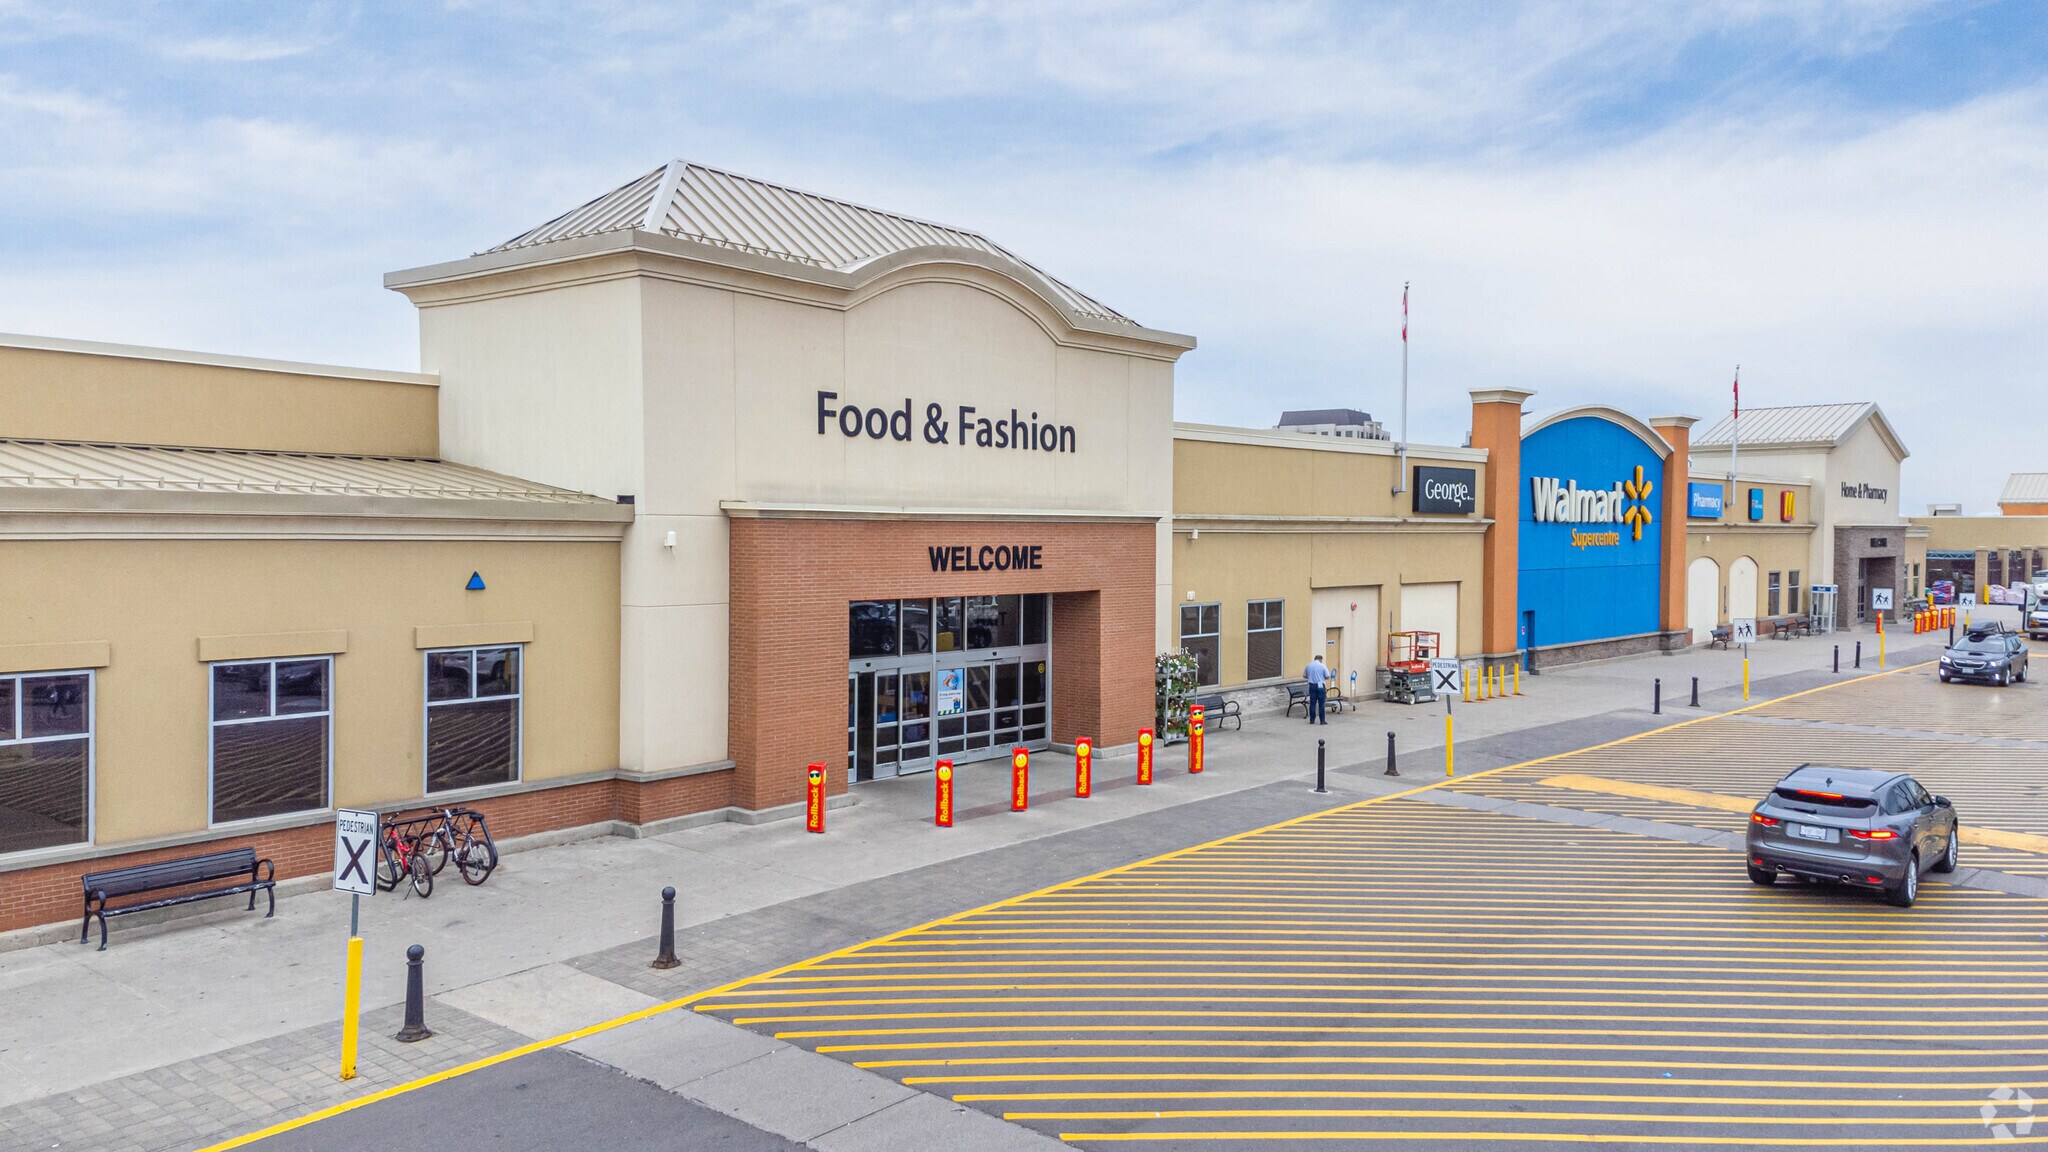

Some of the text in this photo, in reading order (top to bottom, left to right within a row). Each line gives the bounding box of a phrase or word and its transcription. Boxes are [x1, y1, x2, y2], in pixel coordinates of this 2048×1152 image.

[817, 390, 1076, 453] Food & Fashion
[1531, 476, 1625, 524] Walmart
[1693, 492, 1721, 512] Pharmacy
[1841, 481, 1888, 505] Home & Pharmacy
[1571, 527, 1620, 551] Supercentre
[928, 545, 1043, 572] WELCOME
[1432, 661, 1458, 669] PEDESTRIAN
[1078, 757, 1088, 794] Rollback
[1140, 746, 1150, 781] Rollback
[940, 782, 950, 822] Rollback
[1016, 768, 1025, 807] Rollback
[810, 787, 820, 828] Rollback
[339, 819, 374, 835] PEDESTRIAN
